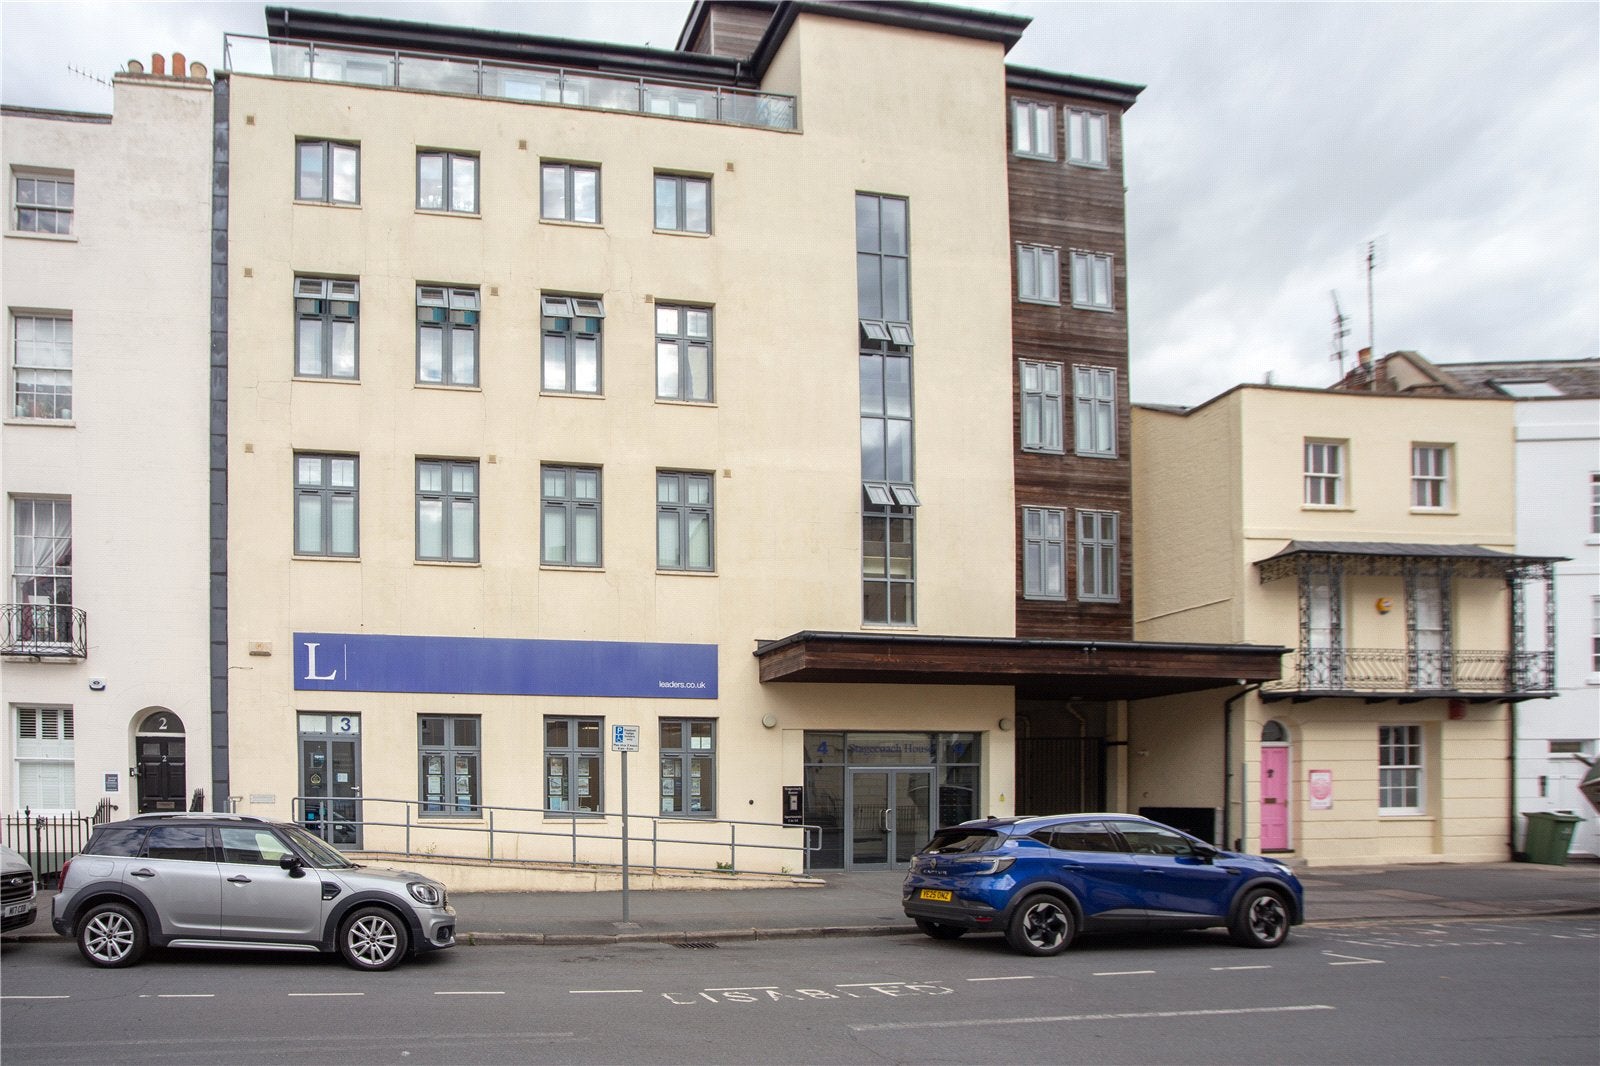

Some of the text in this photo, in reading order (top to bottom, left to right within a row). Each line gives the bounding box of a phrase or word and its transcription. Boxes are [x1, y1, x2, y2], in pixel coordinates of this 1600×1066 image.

[303, 642, 337, 680] L
[658, 680, 706, 689] leaders.co.uk
[159, 718, 168, 729] 2
[340, 718, 351, 731] 3
[817, 741, 829, 755] 4
[848, 742, 902, 757] Stagecoach
